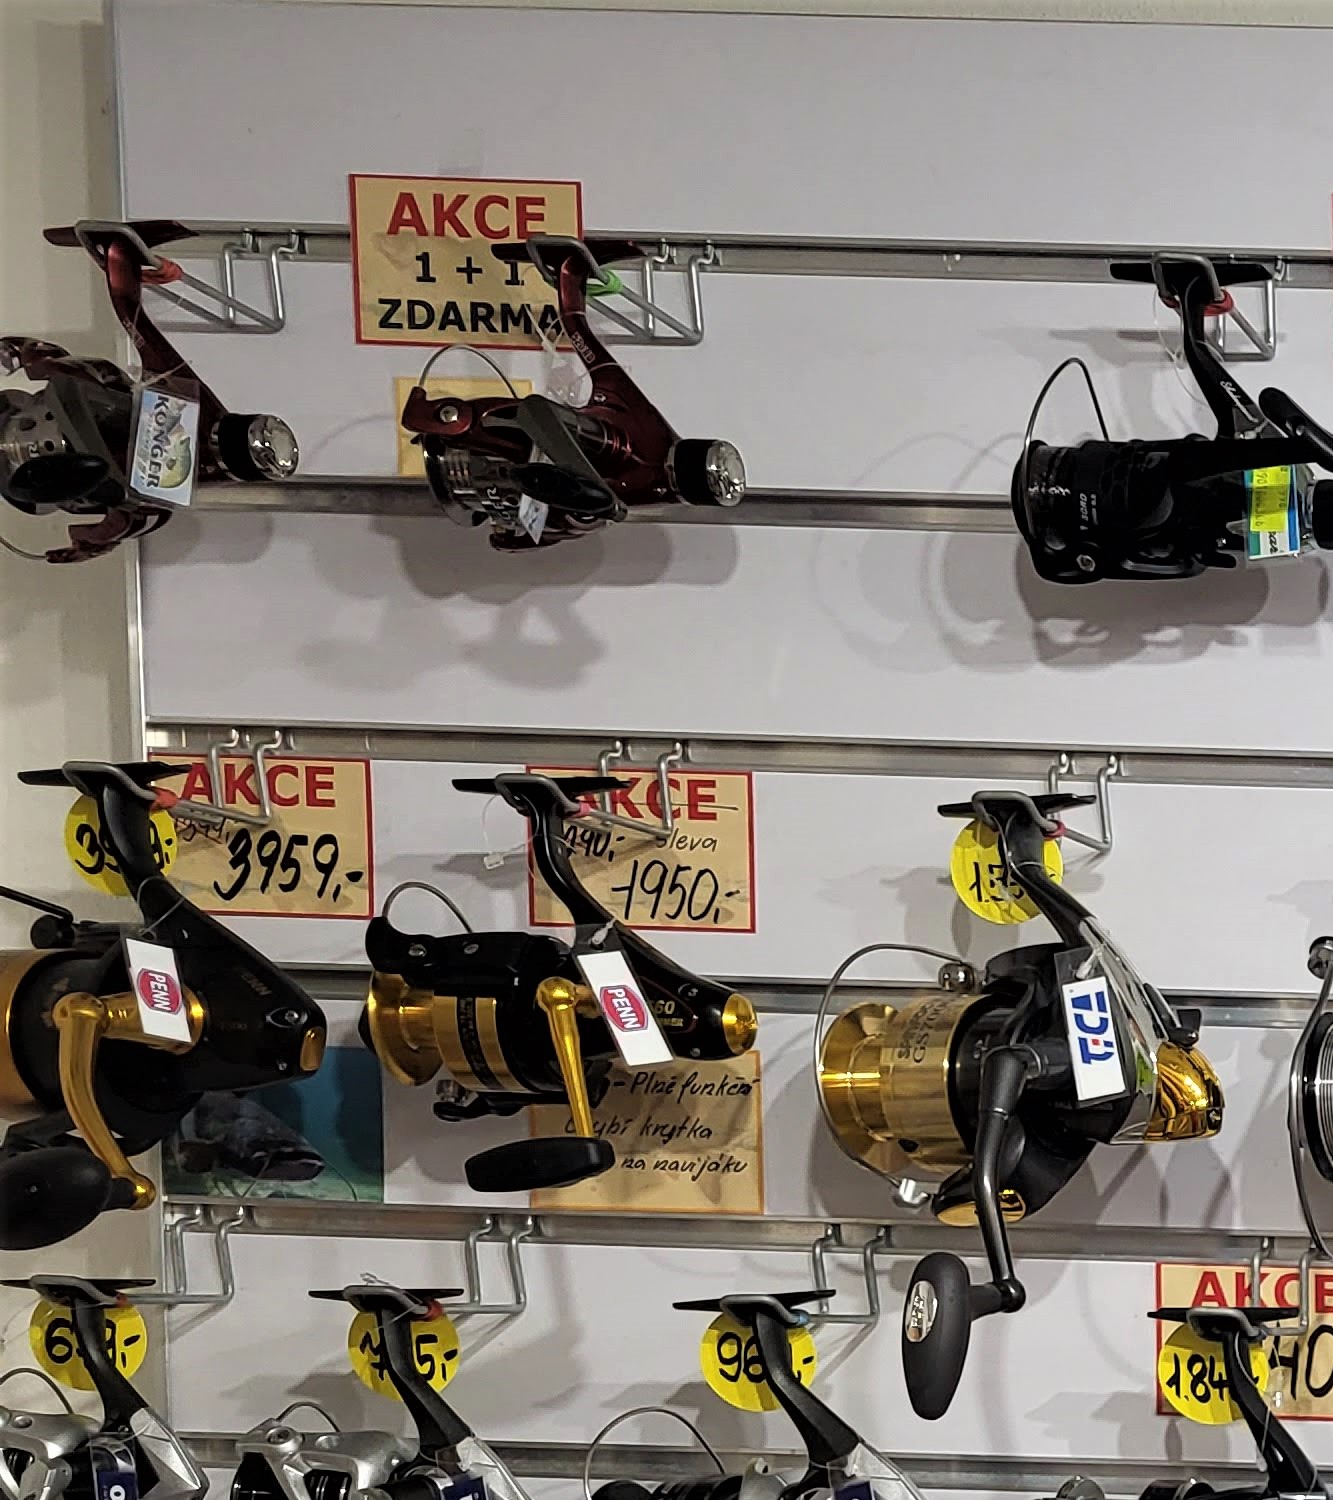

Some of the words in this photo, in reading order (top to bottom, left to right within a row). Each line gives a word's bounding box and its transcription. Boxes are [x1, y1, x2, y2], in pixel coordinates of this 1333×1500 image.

[386, 192, 547, 240] AKCE
[378, 299, 559, 335] ZDARMA
[145, 395, 171, 490] KONGER
[182, 762, 337, 808] AKCE
[580, 777, 719, 822] KCE
[149, 968, 172, 1012] PENN
[606, 984, 641, 1032] PENN
